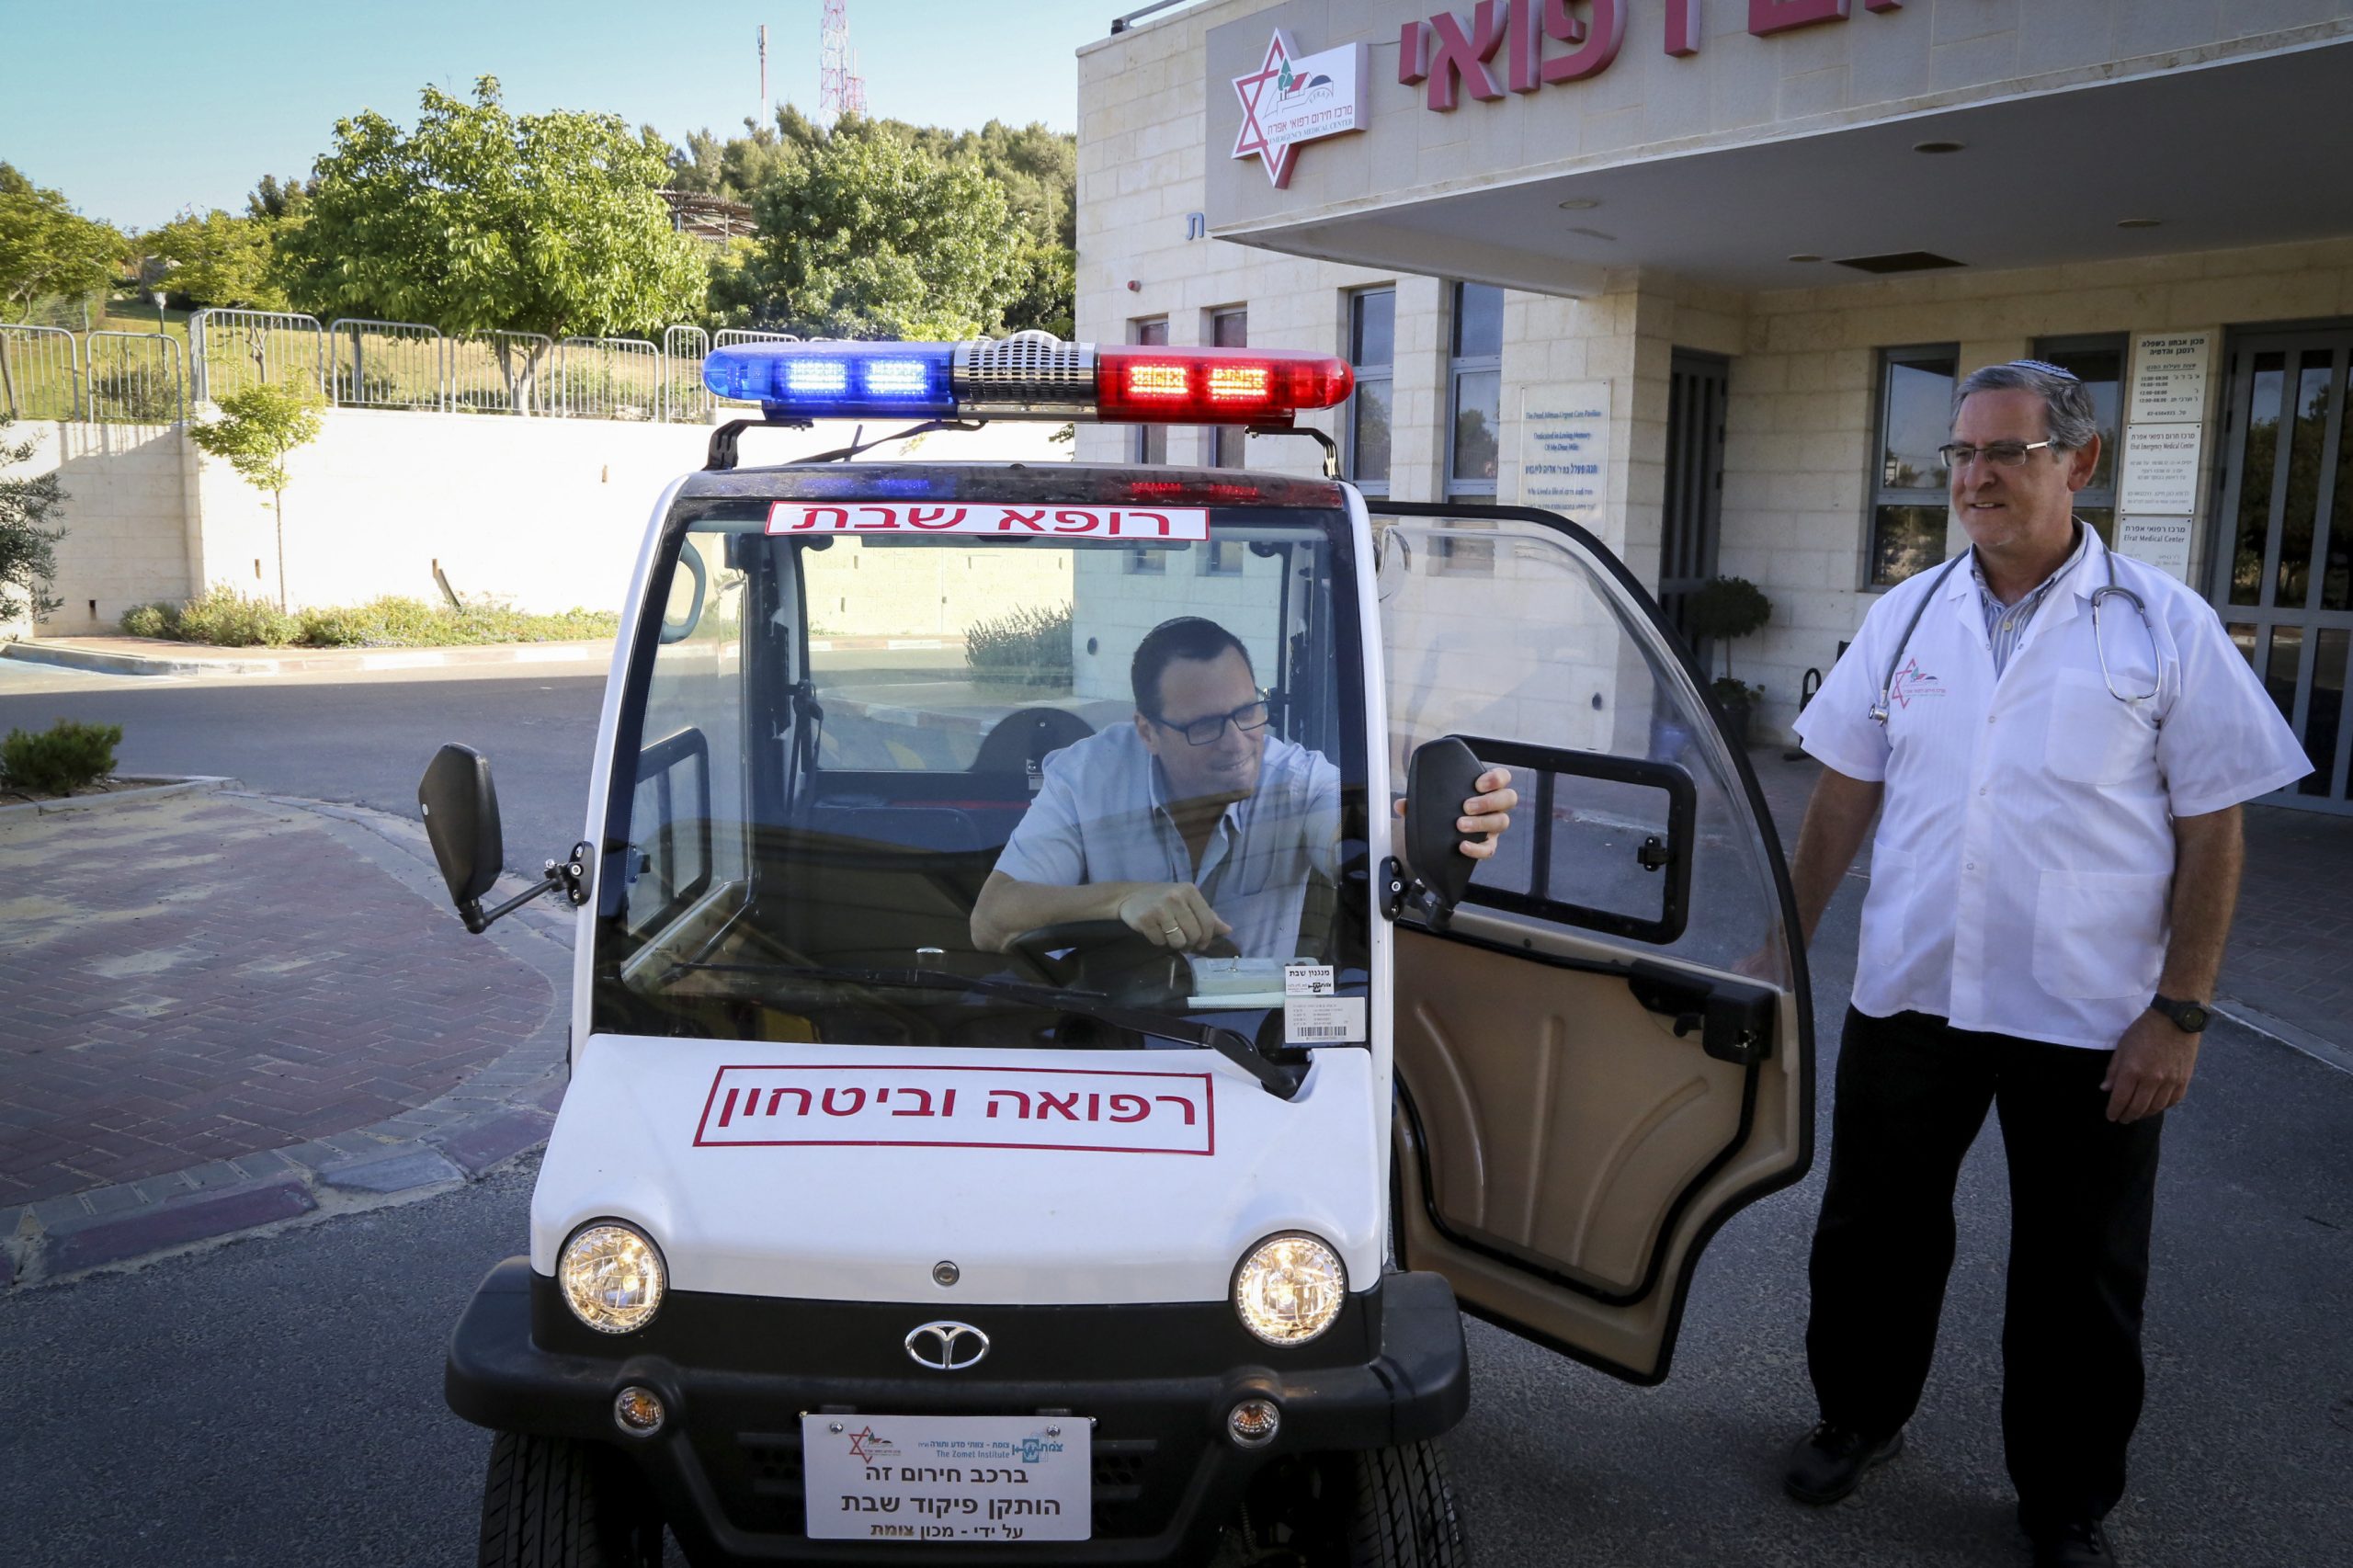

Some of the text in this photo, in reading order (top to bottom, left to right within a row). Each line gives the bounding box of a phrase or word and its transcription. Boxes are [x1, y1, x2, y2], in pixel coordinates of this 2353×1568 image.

[1399, 0, 1700, 112] פואי
[1267, 105, 1352, 135] מרכז חירום רפואי אפרת
[1269, 119, 1353, 144] EMERGENCY MEDICAL CENTER
[791, 506, 1171, 536] רופא שבת
[2164, 535, 2185, 543] Center
[718, 1086, 1196, 1128] רפואה וביטחון
[936, 1449, 1010, 1459] The Zomet Institute
[866, 1465, 1029, 1483] ברכב חירום זה
[841, 1494, 1061, 1520] הותקן פיקוד שבת
[870, 1523, 915, 1537] צומת
[920, 1525, 954, 1540] מכון
[973, 1524, 995, 1539] ידי
[1002, 1523, 1024, 1540] על
